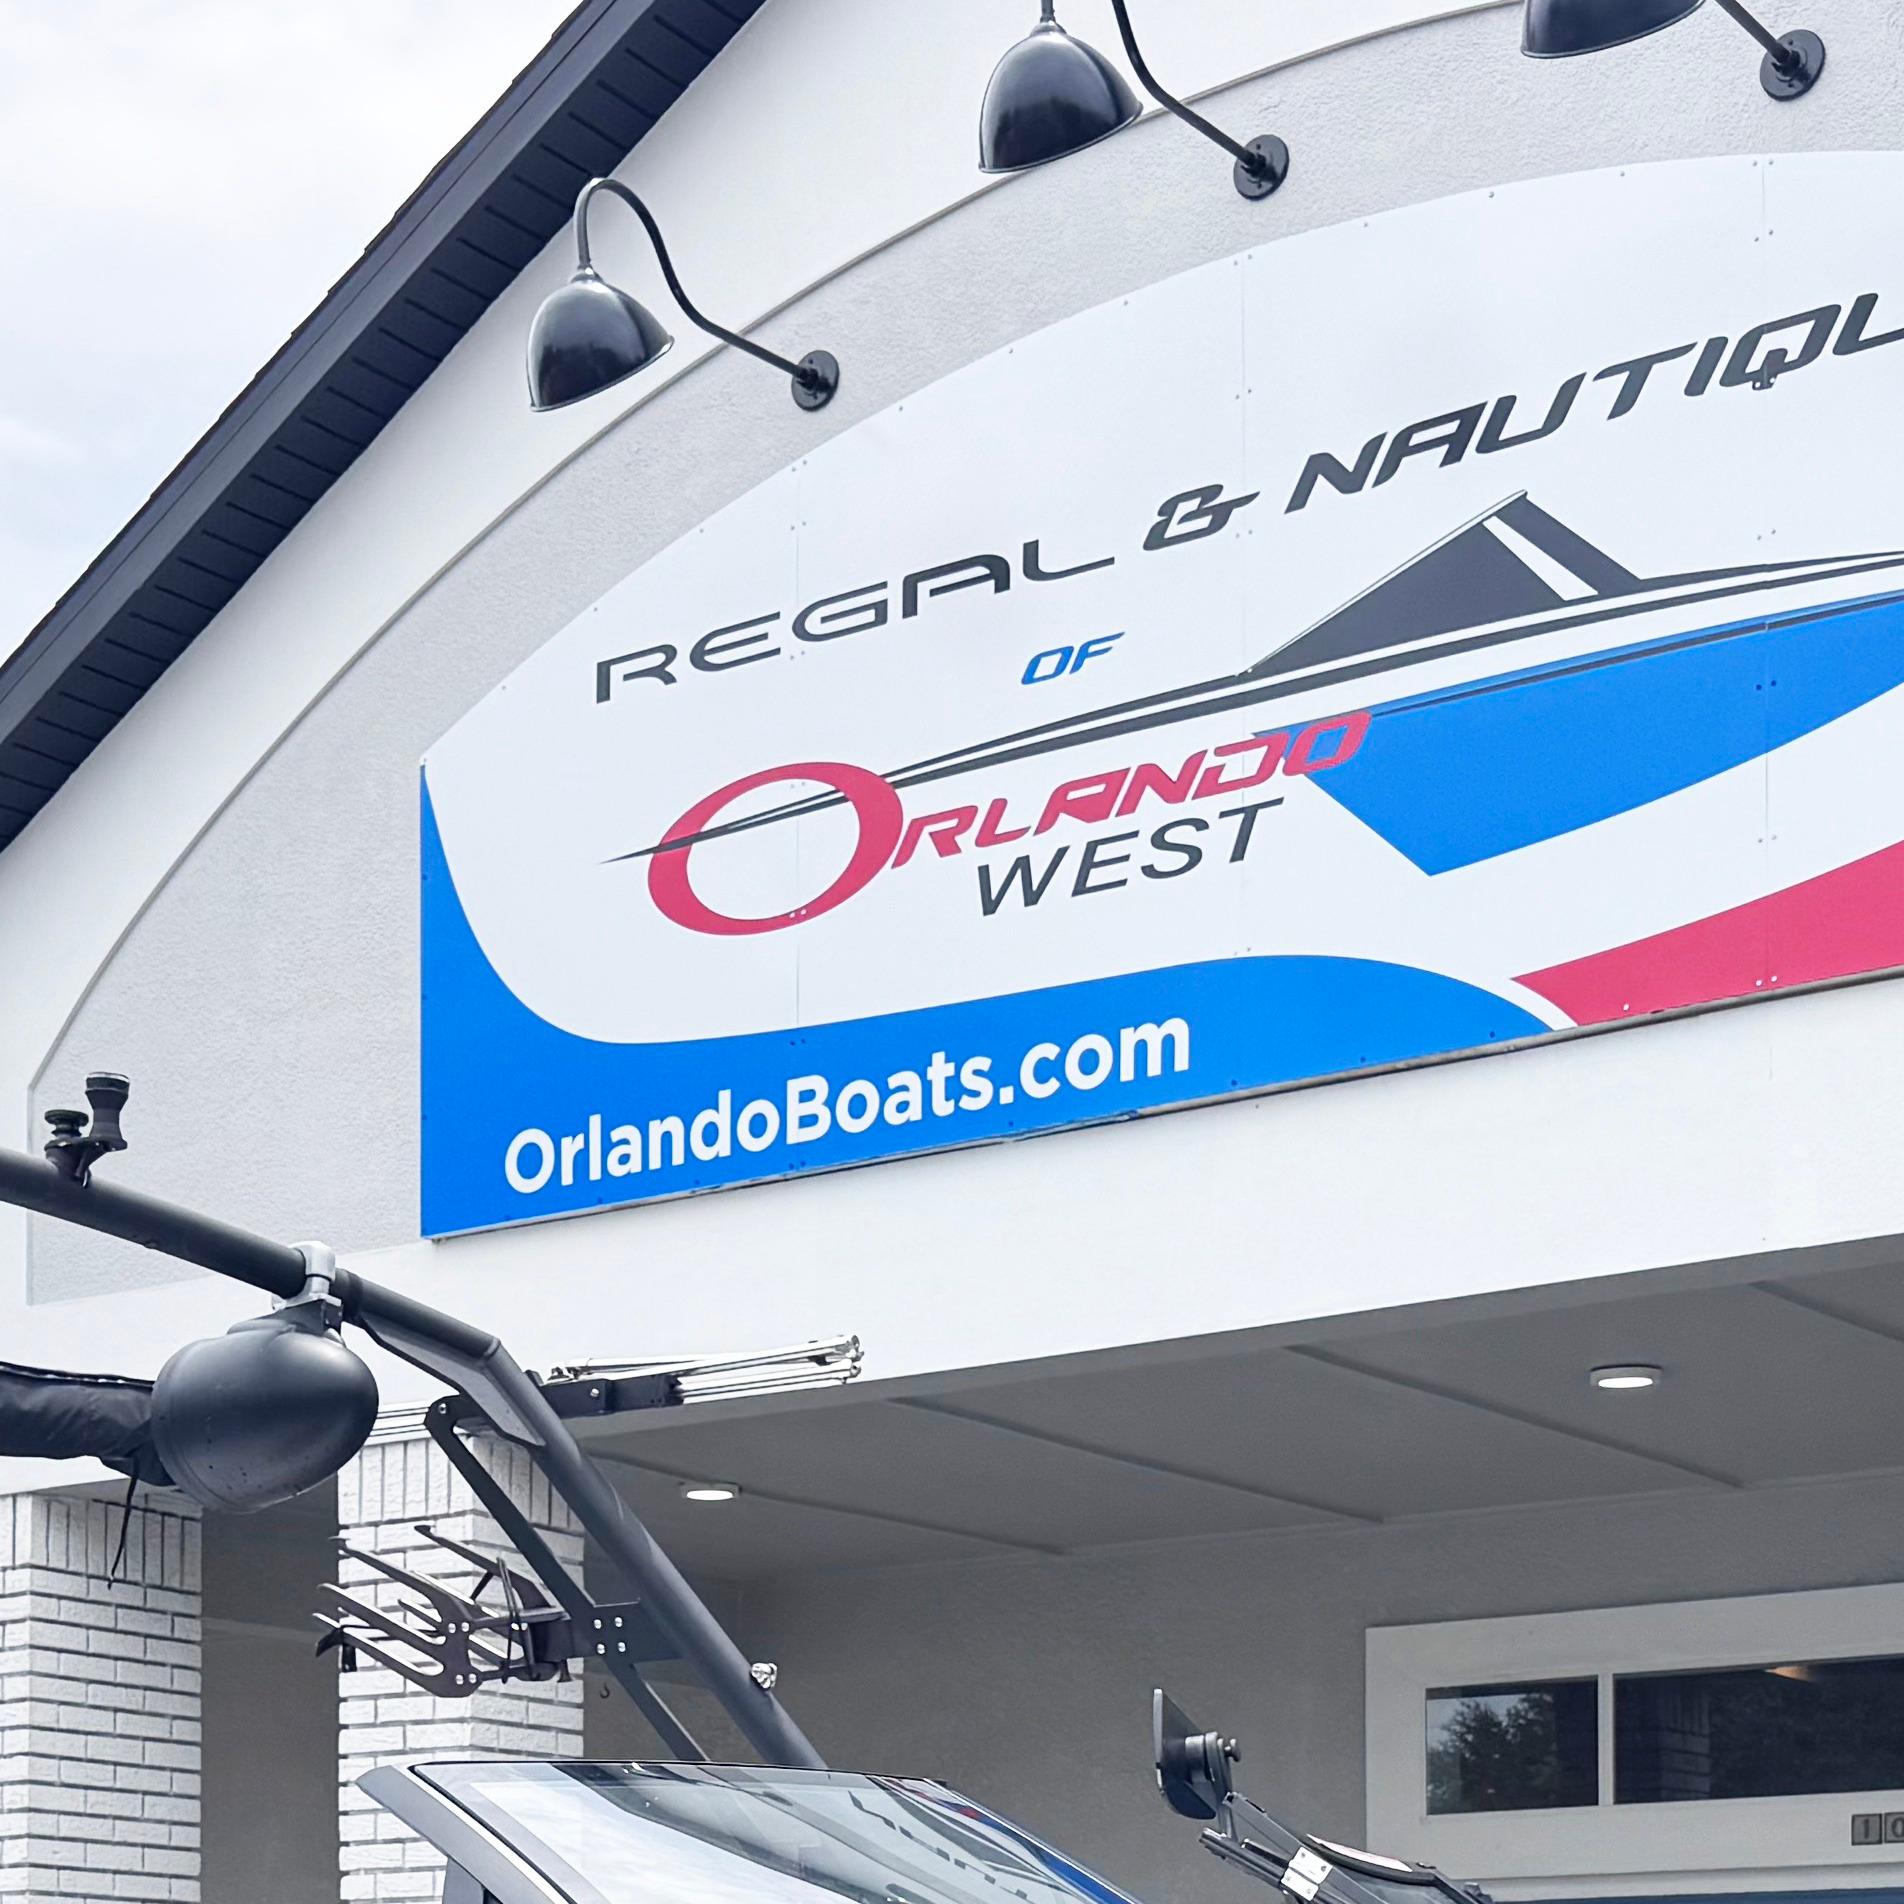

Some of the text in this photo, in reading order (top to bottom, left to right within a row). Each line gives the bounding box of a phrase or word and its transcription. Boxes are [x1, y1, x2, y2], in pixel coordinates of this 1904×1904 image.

[595, 532, 1116, 704] REGAL
[1142, 482, 1261, 552] &
[1020, 631, 1125, 686] OF
[647, 711, 1373, 937] ORLANDO
[976, 797, 1285, 917] WEST
[504, 1015, 1192, 1196] OrlandoBoats.com
